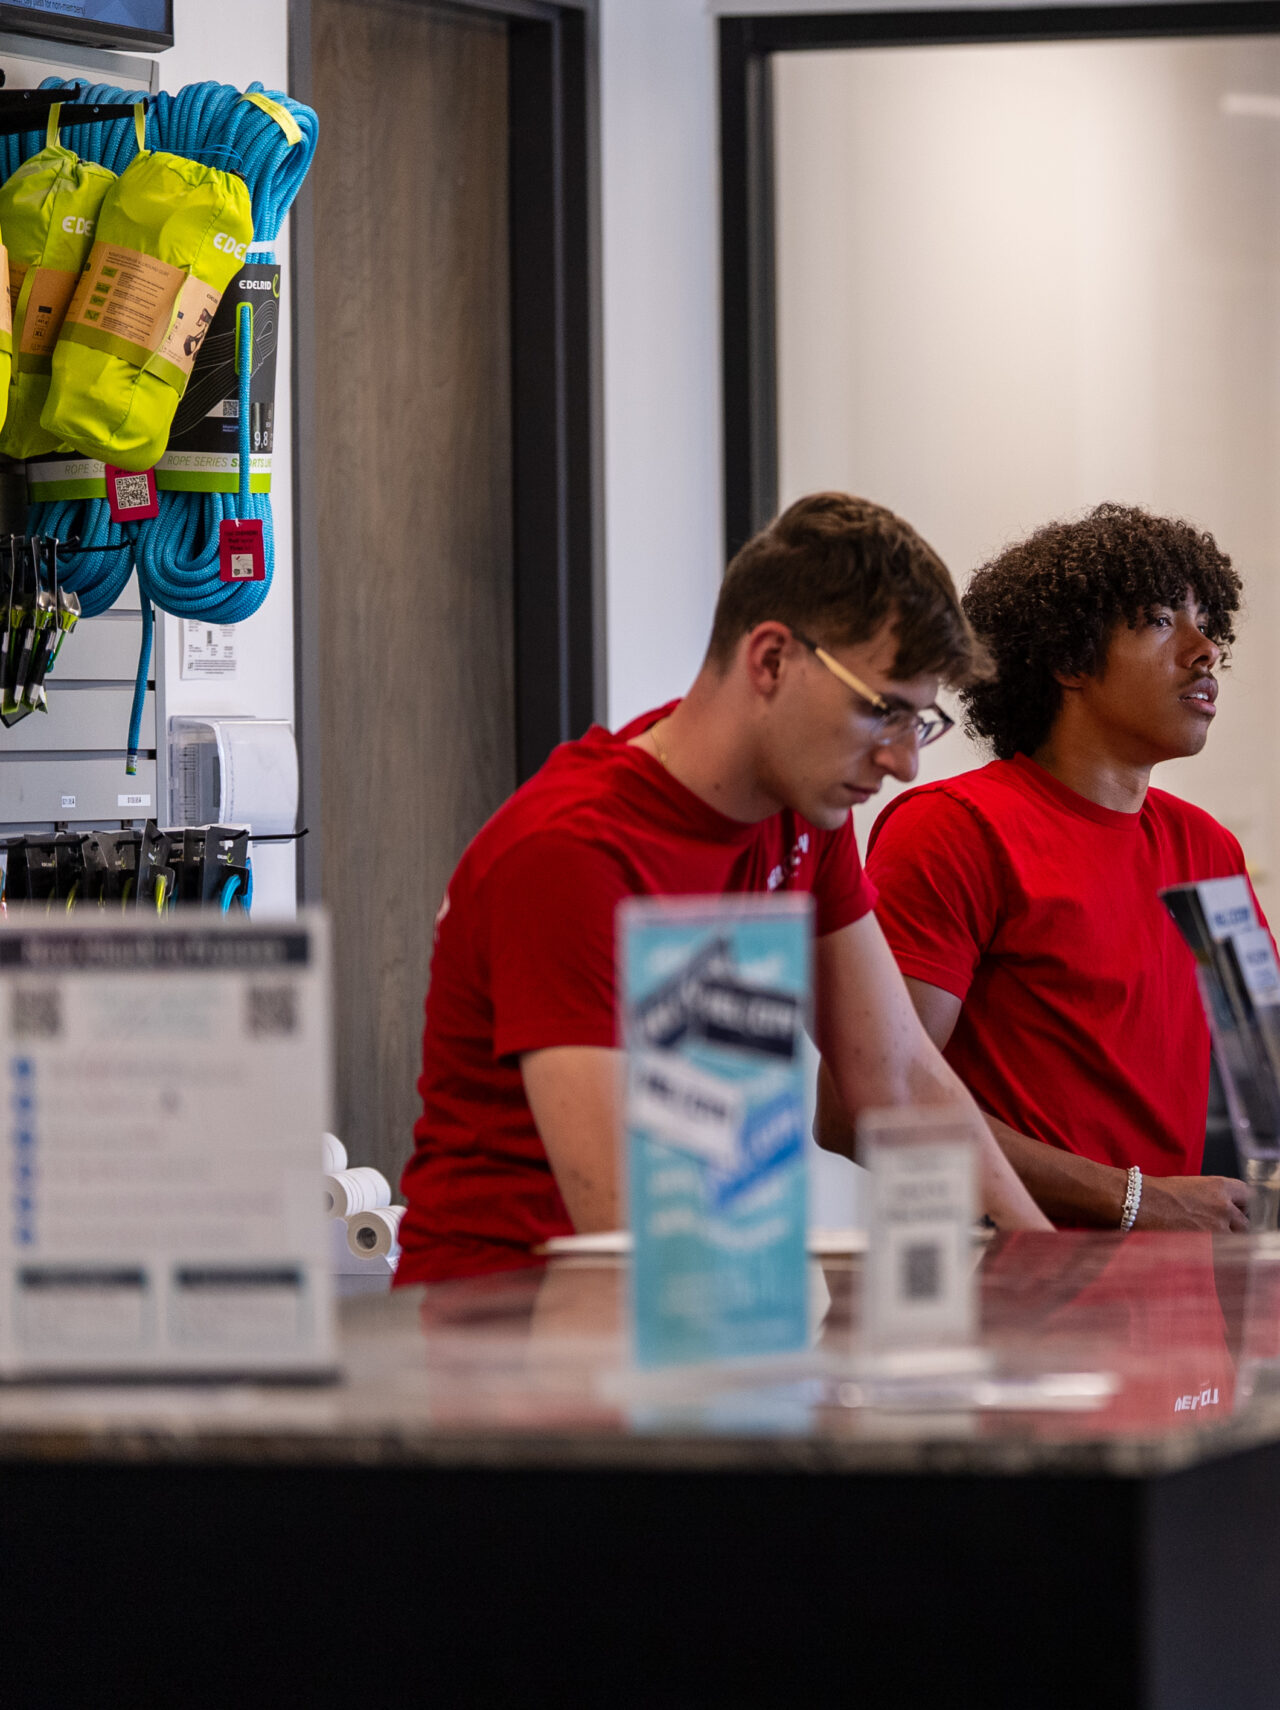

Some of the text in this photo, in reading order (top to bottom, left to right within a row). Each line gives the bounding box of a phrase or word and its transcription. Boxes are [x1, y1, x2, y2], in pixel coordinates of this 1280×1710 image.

[239, 280, 272, 291] EDELRID
[168, 455, 191, 467] ROPE
[193, 457, 227, 468] SERIES
[65, 463, 89, 475] ROPE
